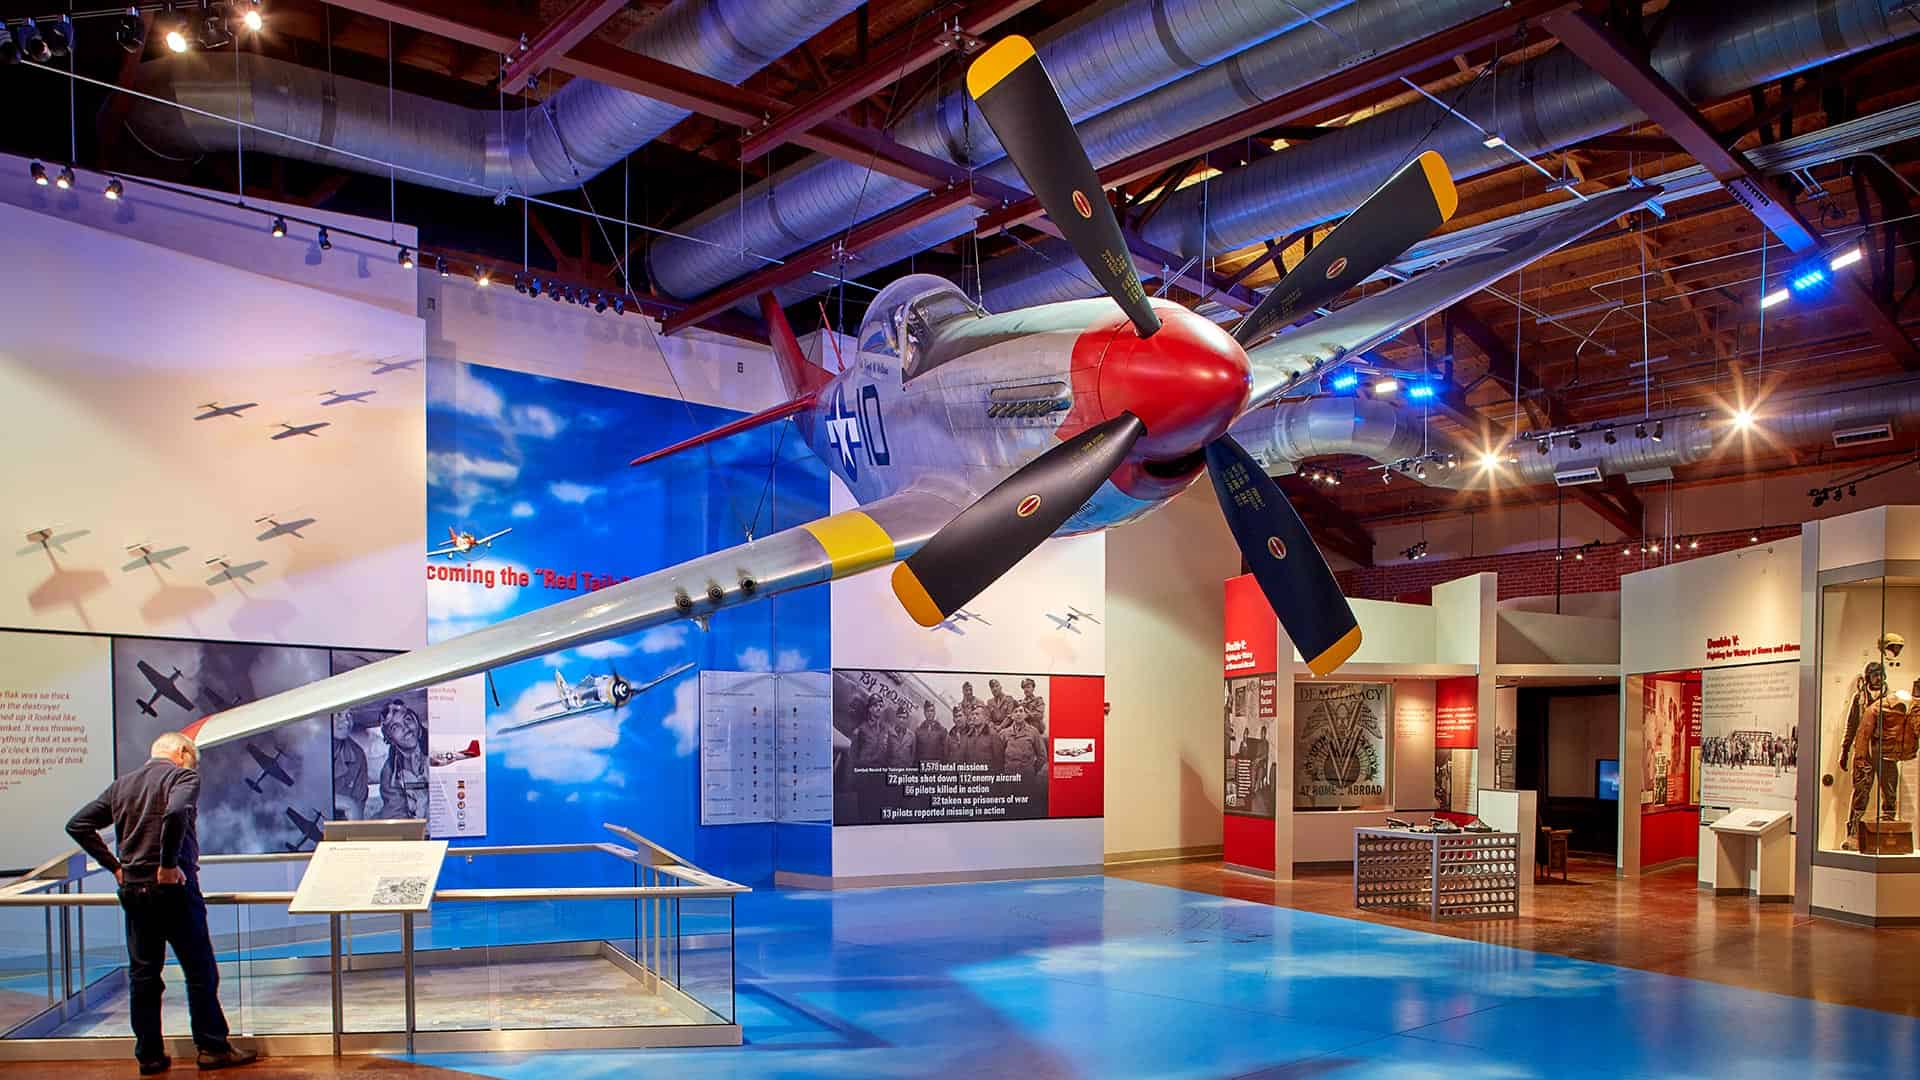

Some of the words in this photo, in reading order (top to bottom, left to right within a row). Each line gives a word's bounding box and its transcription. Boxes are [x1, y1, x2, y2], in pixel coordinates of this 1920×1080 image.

[427, 564, 495, 588] coming
[500, 566, 529, 586] the
[939, 762, 957, 772] total
[957, 762, 989, 772] missions
[888, 774, 898, 785] 72
[898, 774, 919, 786] pilots
[920, 774, 936, 784] shot
[937, 774, 958, 783] down
[959, 774, 972, 783] 112
[972, 774, 995, 785] enemy
[995, 773, 1022, 783] aircraft
[915, 785, 936, 797] pilots
[936, 785, 958, 794] killed
[959, 784, 967, 793] in
[967, 784, 990, 794] action
[1347, 785, 1383, 796] ABROAD
[941, 795, 962, 805] taken
[962, 797, 972, 805] as
[972, 794, 1006, 807] prisoners
[1006, 794, 1015, 804] of
[1014, 796, 1029, 804] war
[882, 808, 892, 818] 13
[892, 808, 914, 820] pilots
[914, 807, 945, 819] reported
[946, 806, 974, 817] missing
[975, 806, 983, 815] in
[983, 806, 1006, 816] action
